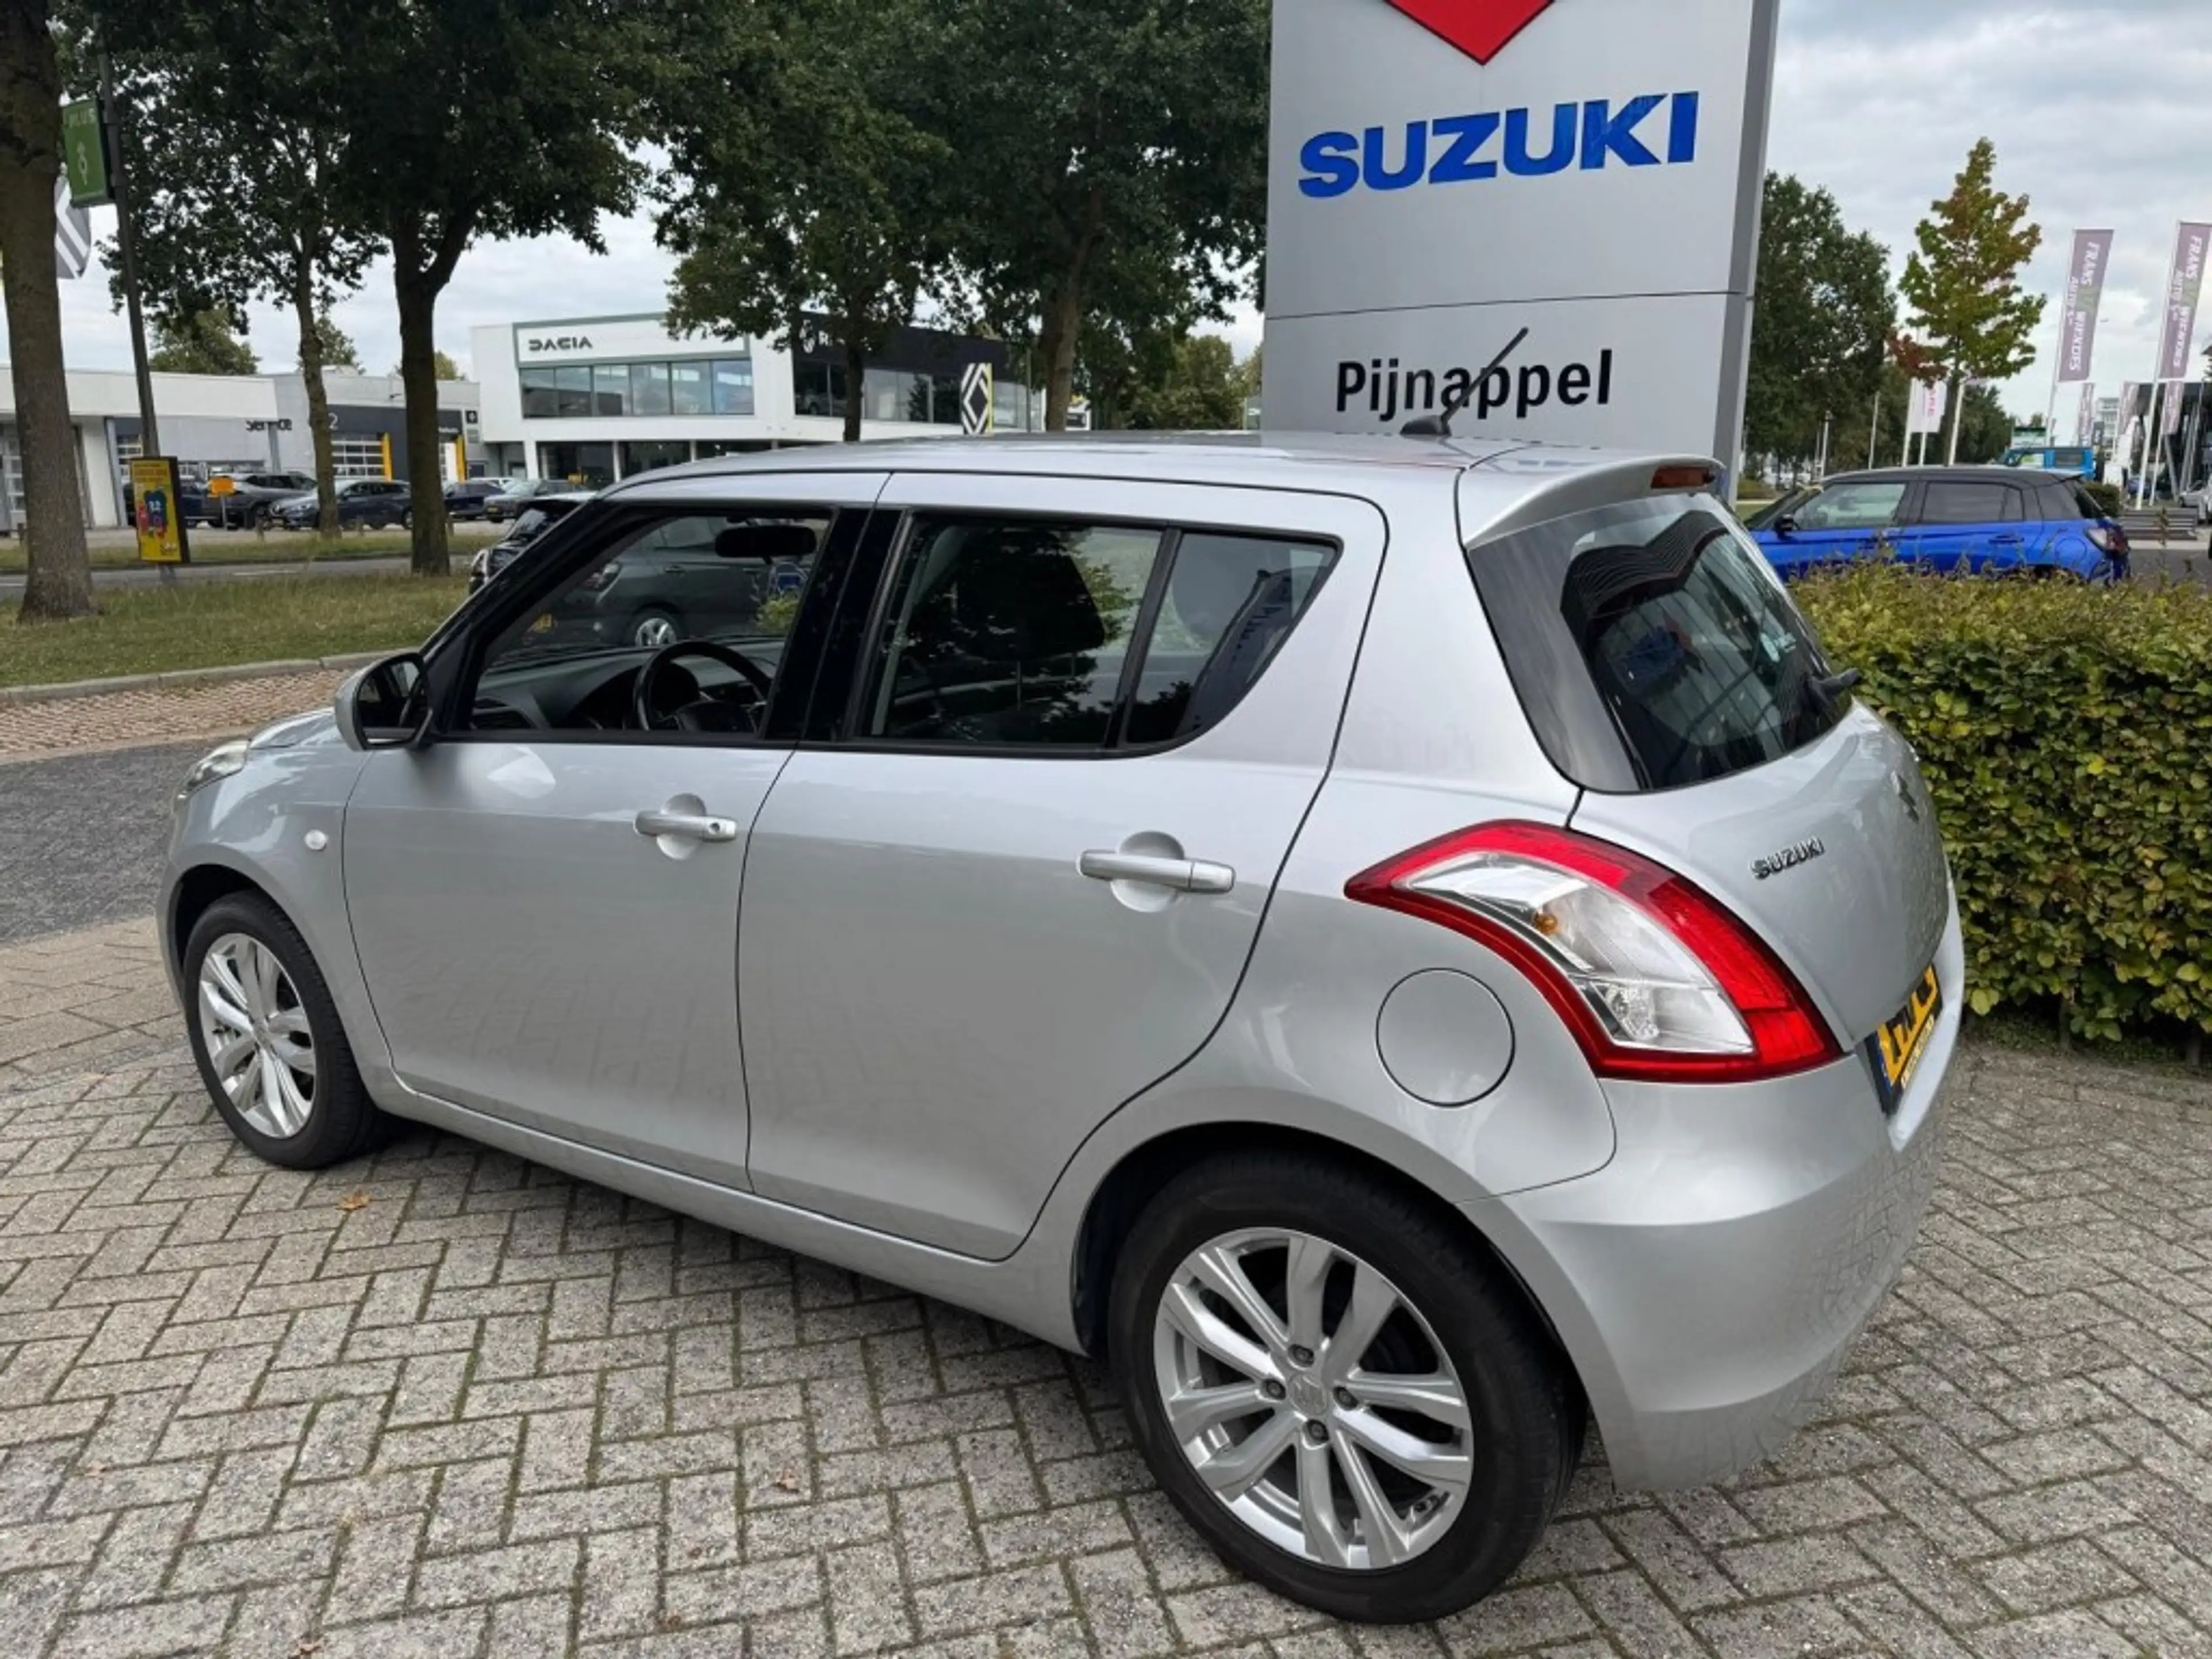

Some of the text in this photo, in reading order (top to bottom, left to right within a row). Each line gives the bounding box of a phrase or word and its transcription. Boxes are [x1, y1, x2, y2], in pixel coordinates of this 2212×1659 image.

[1298, 91, 1699, 198] SUZUKI
[529, 336, 593, 351] DACIA
[1336, 349, 1612, 421] Pijnappel
[1750, 836, 1825, 880] SUZUKI
